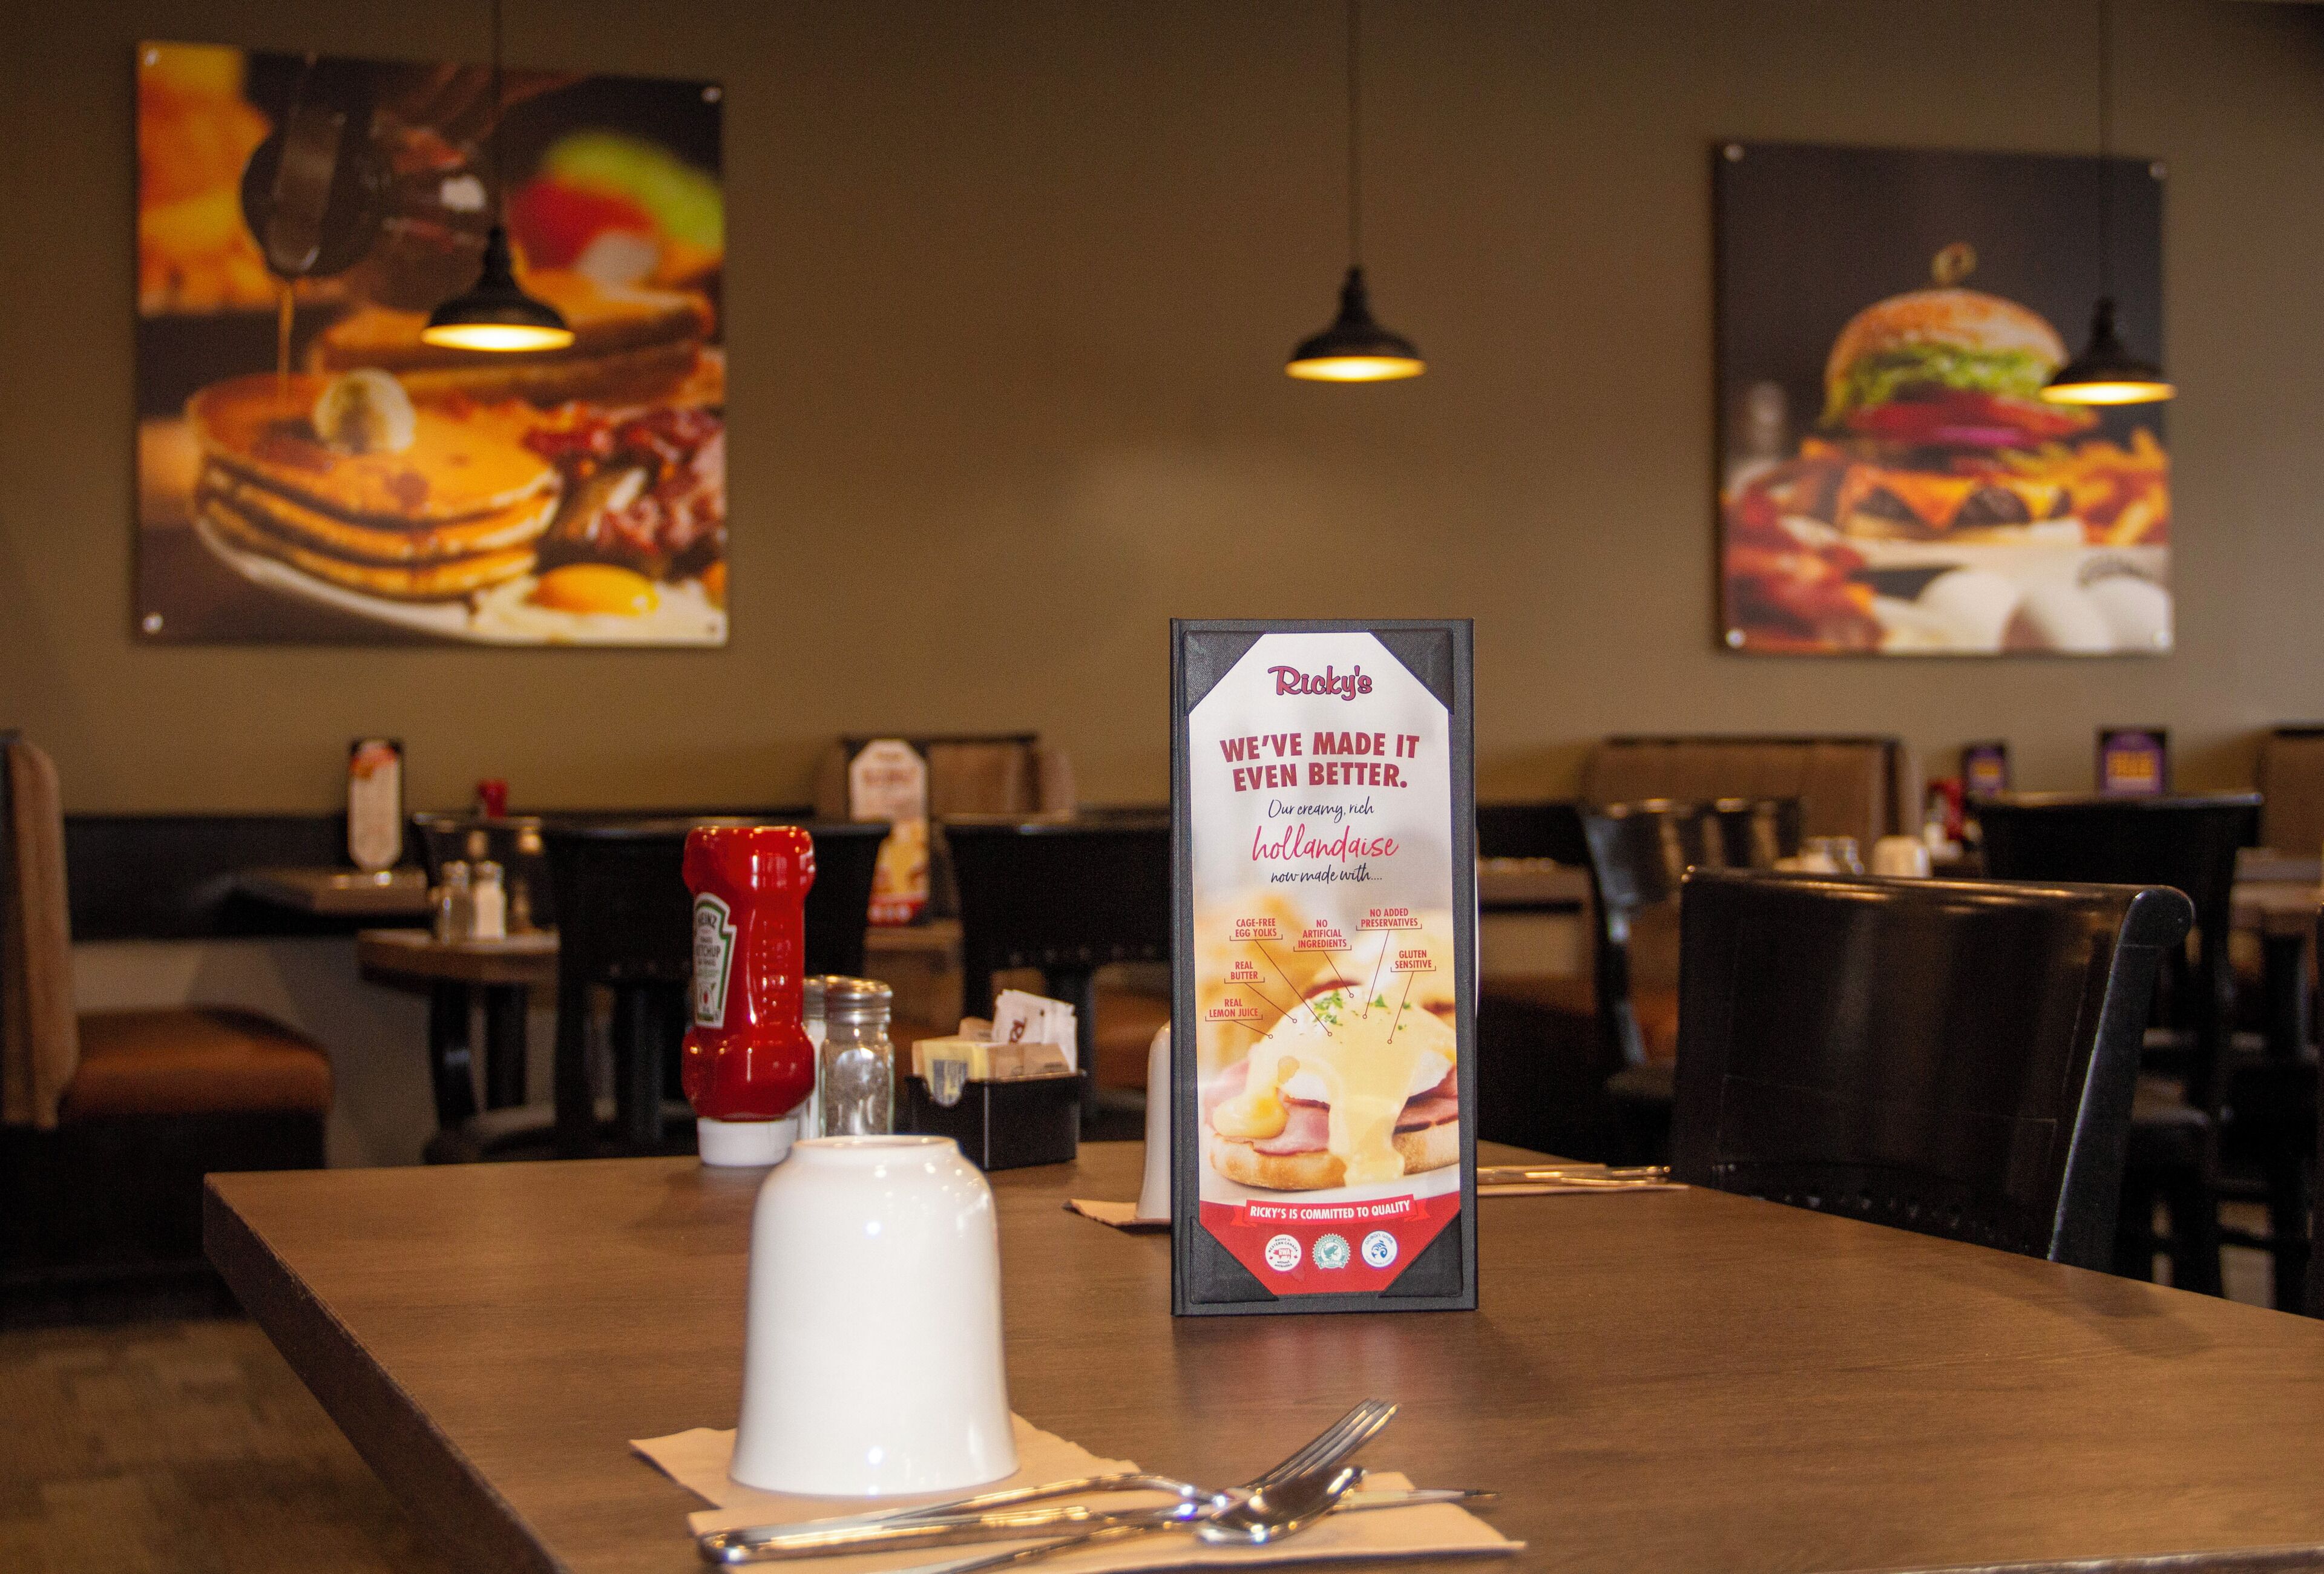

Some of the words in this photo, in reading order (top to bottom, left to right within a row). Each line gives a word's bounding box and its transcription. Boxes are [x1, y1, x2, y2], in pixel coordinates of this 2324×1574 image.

[1267, 665, 1373, 701] Ricky's
[1219, 732, 1302, 762] WE'VE
[1313, 732, 1386, 756] MADE
[1396, 734, 1420, 758] IT
[1233, 763, 1298, 792] EVEN
[1308, 762, 1408, 789] BETTER.
[1268, 799, 1295, 818] Our
[1297, 804, 1346, 824] creamy,
[1349, 796, 1375, 815] rich
[1252, 823, 1399, 863] hollandaise
[1270, 870, 1299, 883] now
[1301, 864, 1338, 884] made
[1370, 908, 1382, 917] NO
[1384, 908, 1409, 916] ADDED
[1236, 917, 1276, 928] CAGE-FREE
[1316, 919, 1328, 928] NO
[1361, 917, 1418, 927] PRESERVATIVES
[1235, 928, 1251, 937] EGG
[1253, 928, 1277, 937] YOLKS
[1302, 929, 1342, 938] ARTIFICIAL
[1298, 939, 1347, 948] INGREDIENTS
[1399, 949, 1427, 959] GLUTEN
[1235, 960, 1253, 969] REAL
[1394, 959, 1432, 969] SENSITIVE
[1230, 971, 1258, 980] BUTTER
[1224, 998, 1243, 1007] REAL
[1209, 1009, 1236, 1017] LEMON
[1238, 1008, 1258, 1017] JUICE
[1250, 1205, 1287, 1219] RICKY'S
[1289, 1208, 1298, 1219] IS
[1300, 1208, 1354, 1219] COMMITTED
[1356, 1206, 1369, 1218] TO
[1371, 1200, 1410, 1216] QUALITY
[1284, 1241, 1298, 1252] CANADA
